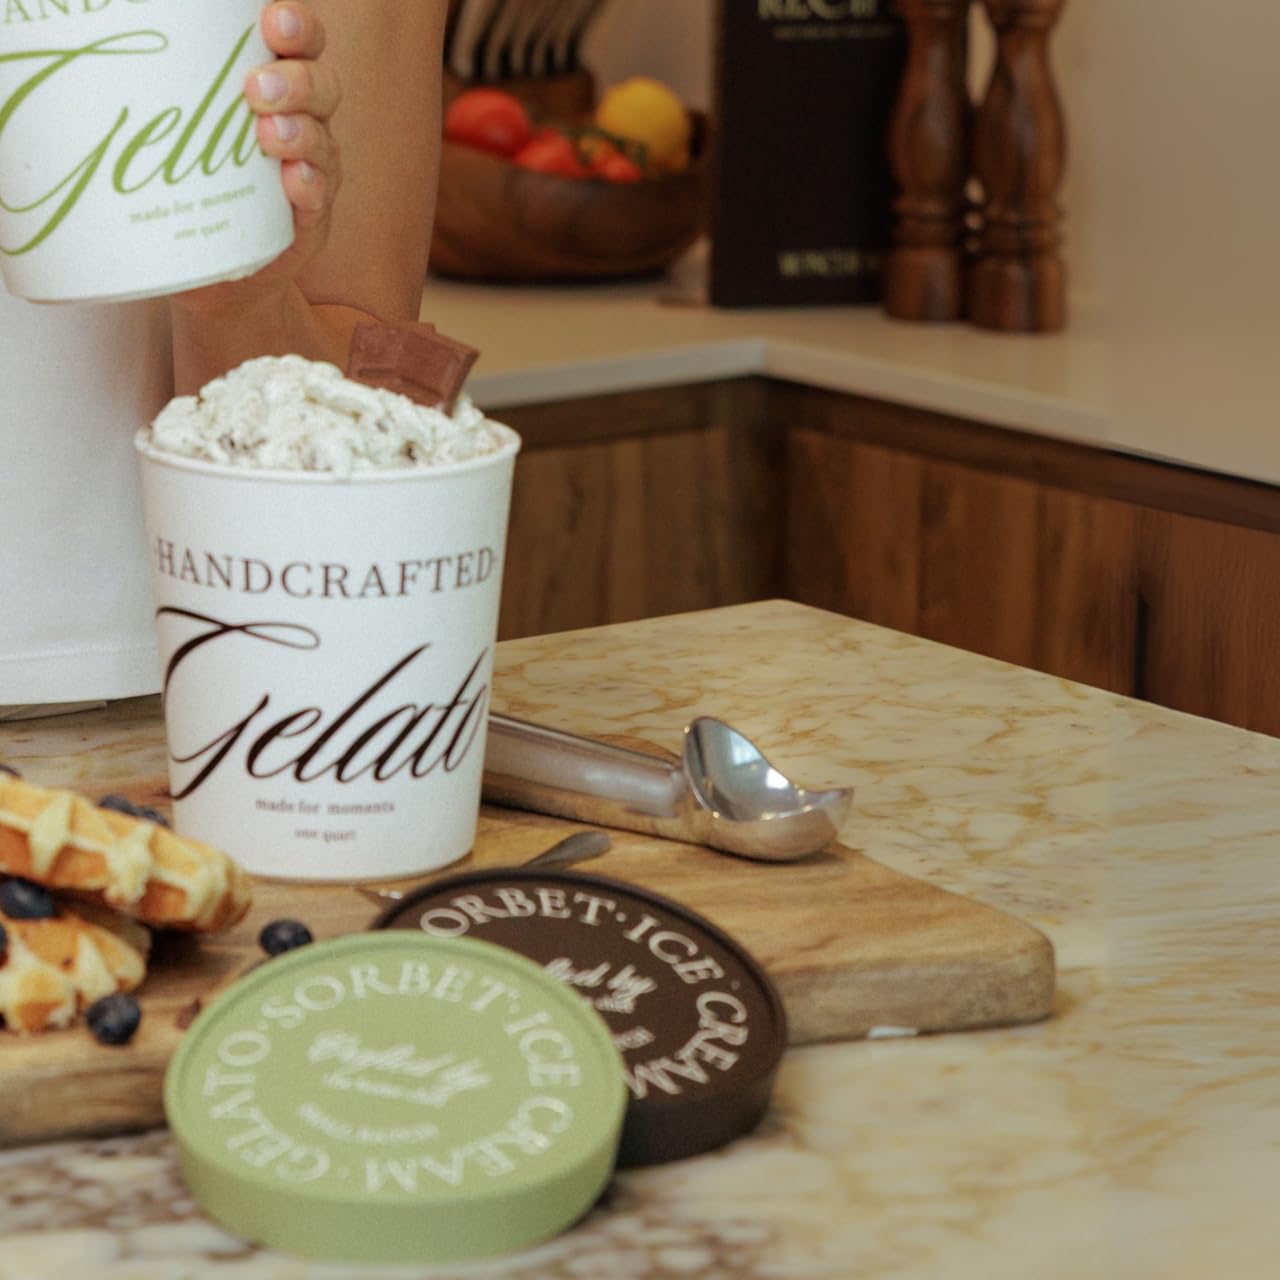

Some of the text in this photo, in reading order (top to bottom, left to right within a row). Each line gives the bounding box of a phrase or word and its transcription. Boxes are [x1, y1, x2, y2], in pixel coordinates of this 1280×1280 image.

[157, 537, 494, 599] HANDCRAFTED
[155, 605, 488, 801] Gelato
[255, 798, 396, 815] made for moments
[260, 958, 521, 1030] SORBET
[420, 887, 749, 1100] ORBET ICE CREAM
[503, 1009, 581, 1089] ICE
[202, 1030, 331, 1183] GELATO
[365, 1095, 574, 1193] CREAM
